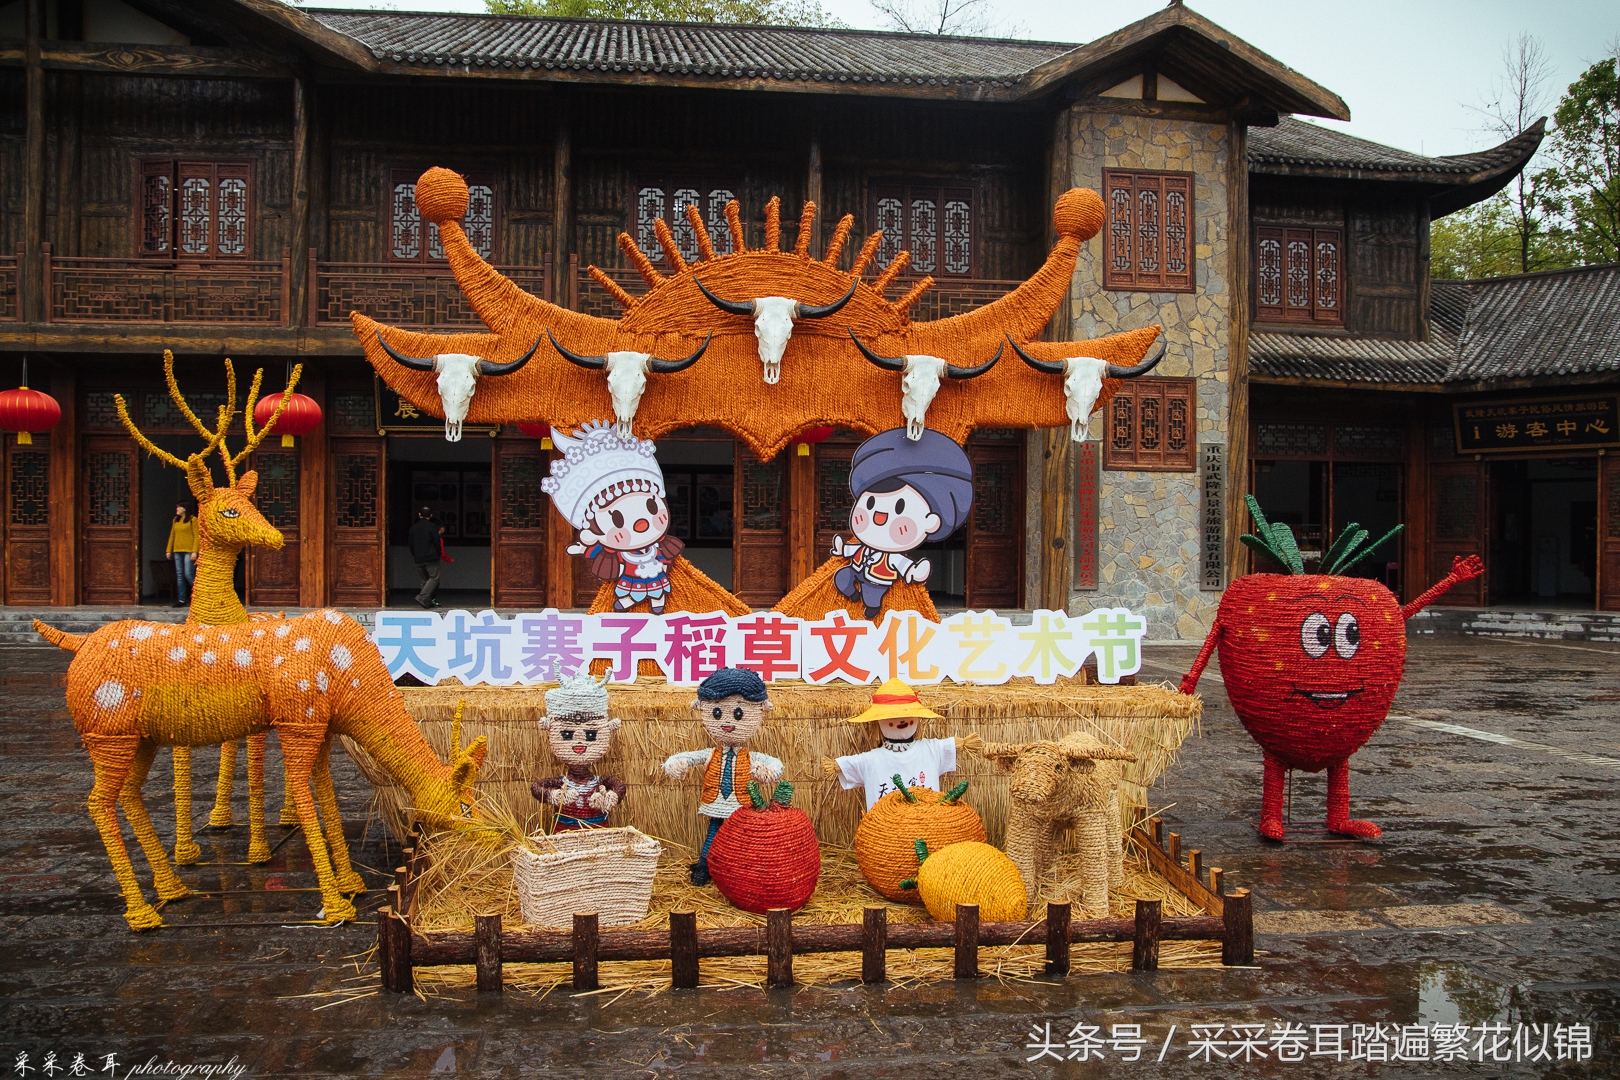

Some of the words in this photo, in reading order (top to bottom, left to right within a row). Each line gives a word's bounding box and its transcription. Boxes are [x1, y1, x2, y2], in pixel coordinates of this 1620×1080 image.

[1495, 418, 1610, 440] 游客中心
[1204, 445, 1222, 587] 重庆市武隆区景乐旅游投资有限公司
[377, 613, 1142, 682] 天坑寨子稻草文化艺术节
